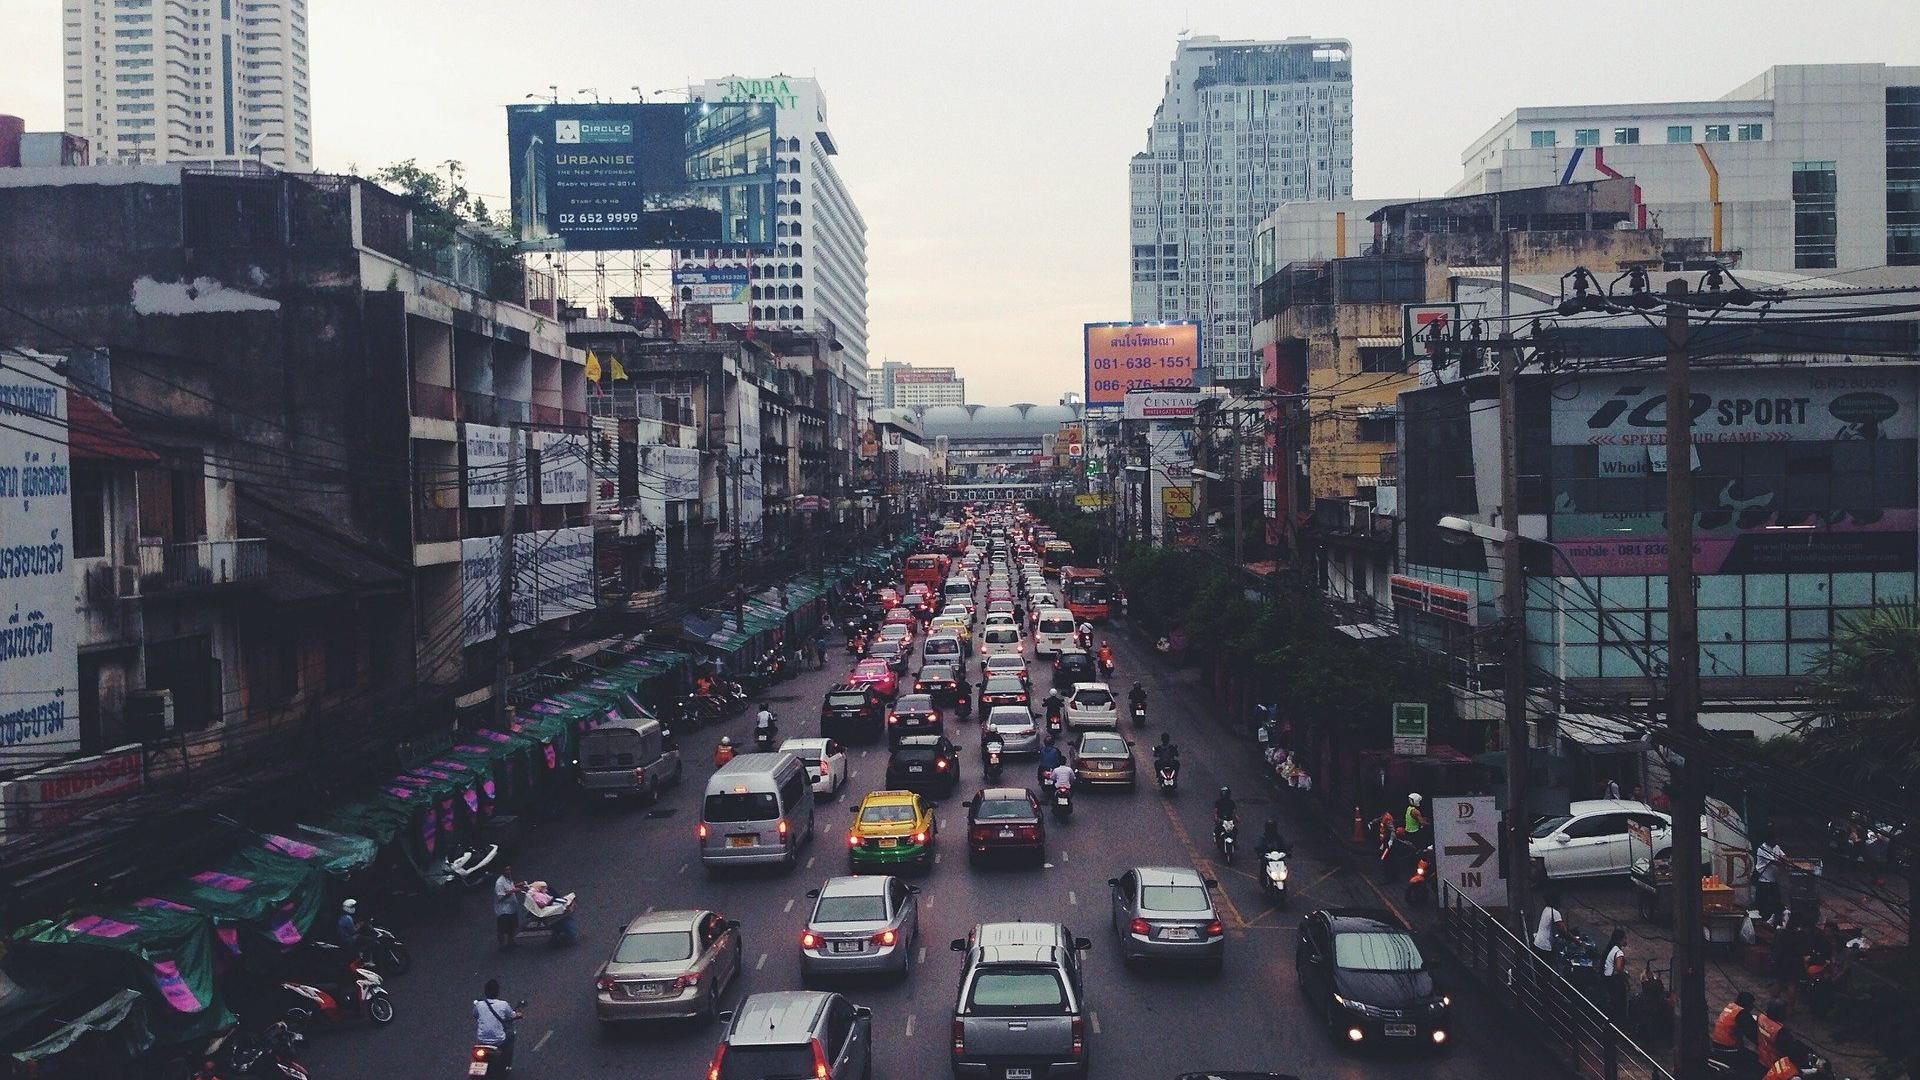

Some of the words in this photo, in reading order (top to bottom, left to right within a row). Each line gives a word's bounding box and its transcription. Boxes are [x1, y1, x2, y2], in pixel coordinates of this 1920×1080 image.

[730, 81, 789, 95] INDRA
[556, 154, 635, 165] URBANISE
[559, 213, 575, 223] 02
[580, 213, 603, 223] 652
[607, 213, 638, 222] 9999
[1094, 356, 1192, 371] 081-638-1551
[1094, 377, 1193, 393] 086-376-1522
[1717, 398, 1811, 426] SPORT
[1719, 431, 1762, 443] GAME
[1461, 872, 1482, 888] IN
